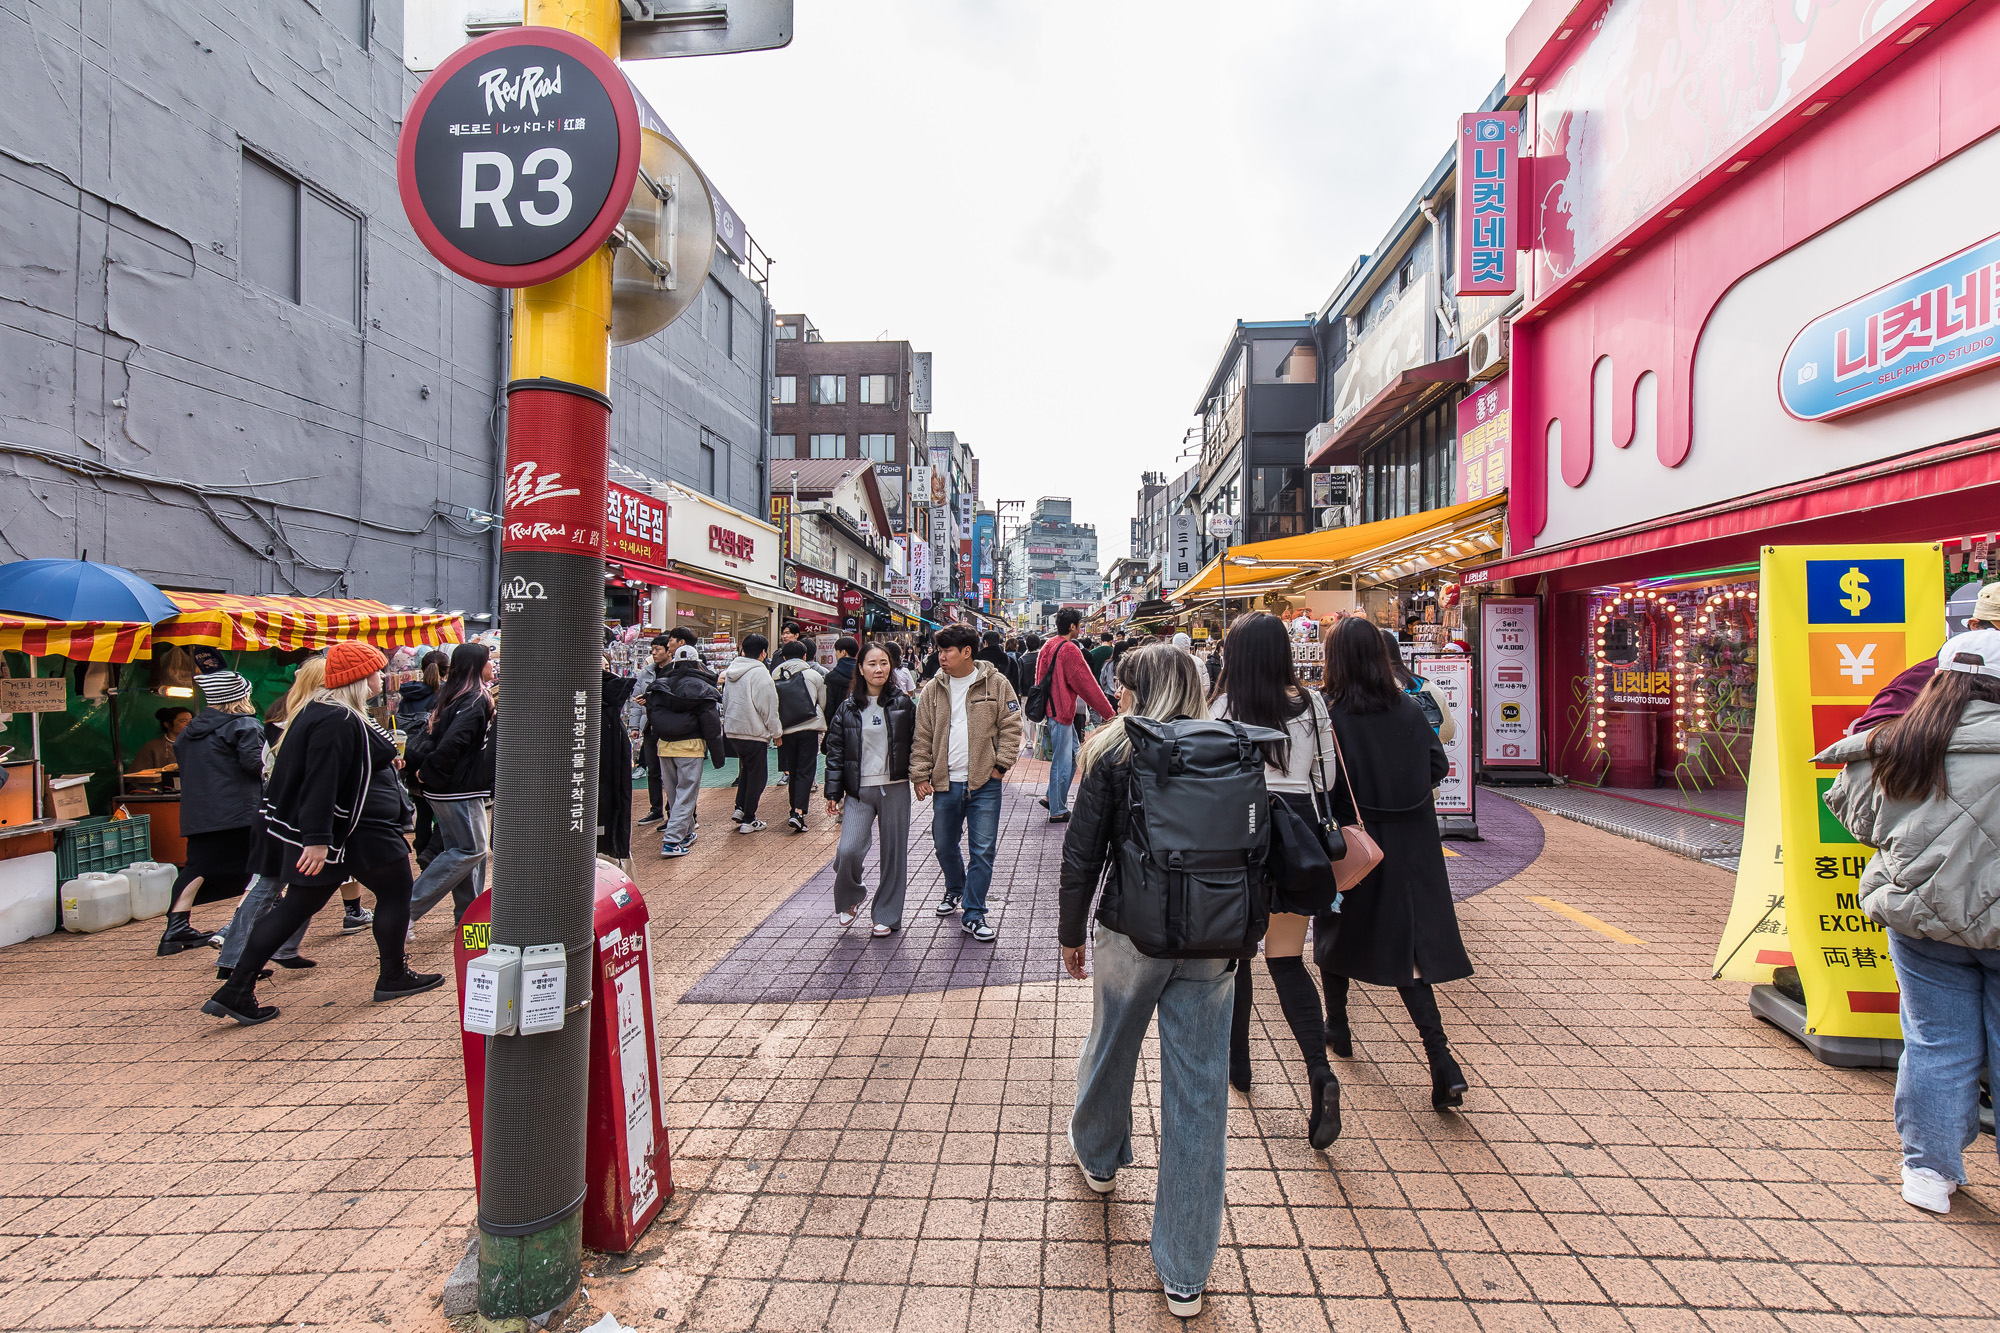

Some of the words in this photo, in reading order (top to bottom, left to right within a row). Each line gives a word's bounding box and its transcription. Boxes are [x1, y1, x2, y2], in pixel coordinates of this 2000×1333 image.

[478, 67, 519, 116] Red
[519, 64, 562, 116] Road
[449, 123, 492, 136] 레드로드
[564, 117, 586, 131] 红路
[460, 147, 573, 228] R3
[724, 216, 733, 232] 2F
[1473, 147, 1506, 283] 니컷네컷
[1835, 260, 2000, 381] 니컷네
[1878, 368, 1904, 385] SELF
[1905, 353, 1946, 376] PHOTO
[1948, 335, 1995, 360] STUDIO
[1468, 449, 1504, 500] 전문
[509, 522, 531, 541] Red
[532, 522, 566, 542] Road
[708, 525, 755, 562] 인생네컷
[933, 509, 947, 568] 코코버블티
[619, 540, 651, 558] 악세사리
[1177, 532, 1189, 573] 三丁目
[1464, 570, 1489, 584] 니컷네컷
[843, 596, 861, 604] 부동산
[1838, 566, 1871, 617] $
[1502, 634, 1519, 643] 1+1
[1429, 664, 1458, 672] 니컷네컷
[1613, 671, 1671, 694] 니컷네컷
[1613, 695, 1627, 703] SELF
[1627, 695, 1647, 704] PHOTO
[1647, 696, 1671, 705] STUDIO
[1248, 802, 1256, 834] THULE
[631, 954, 640, 965] use
